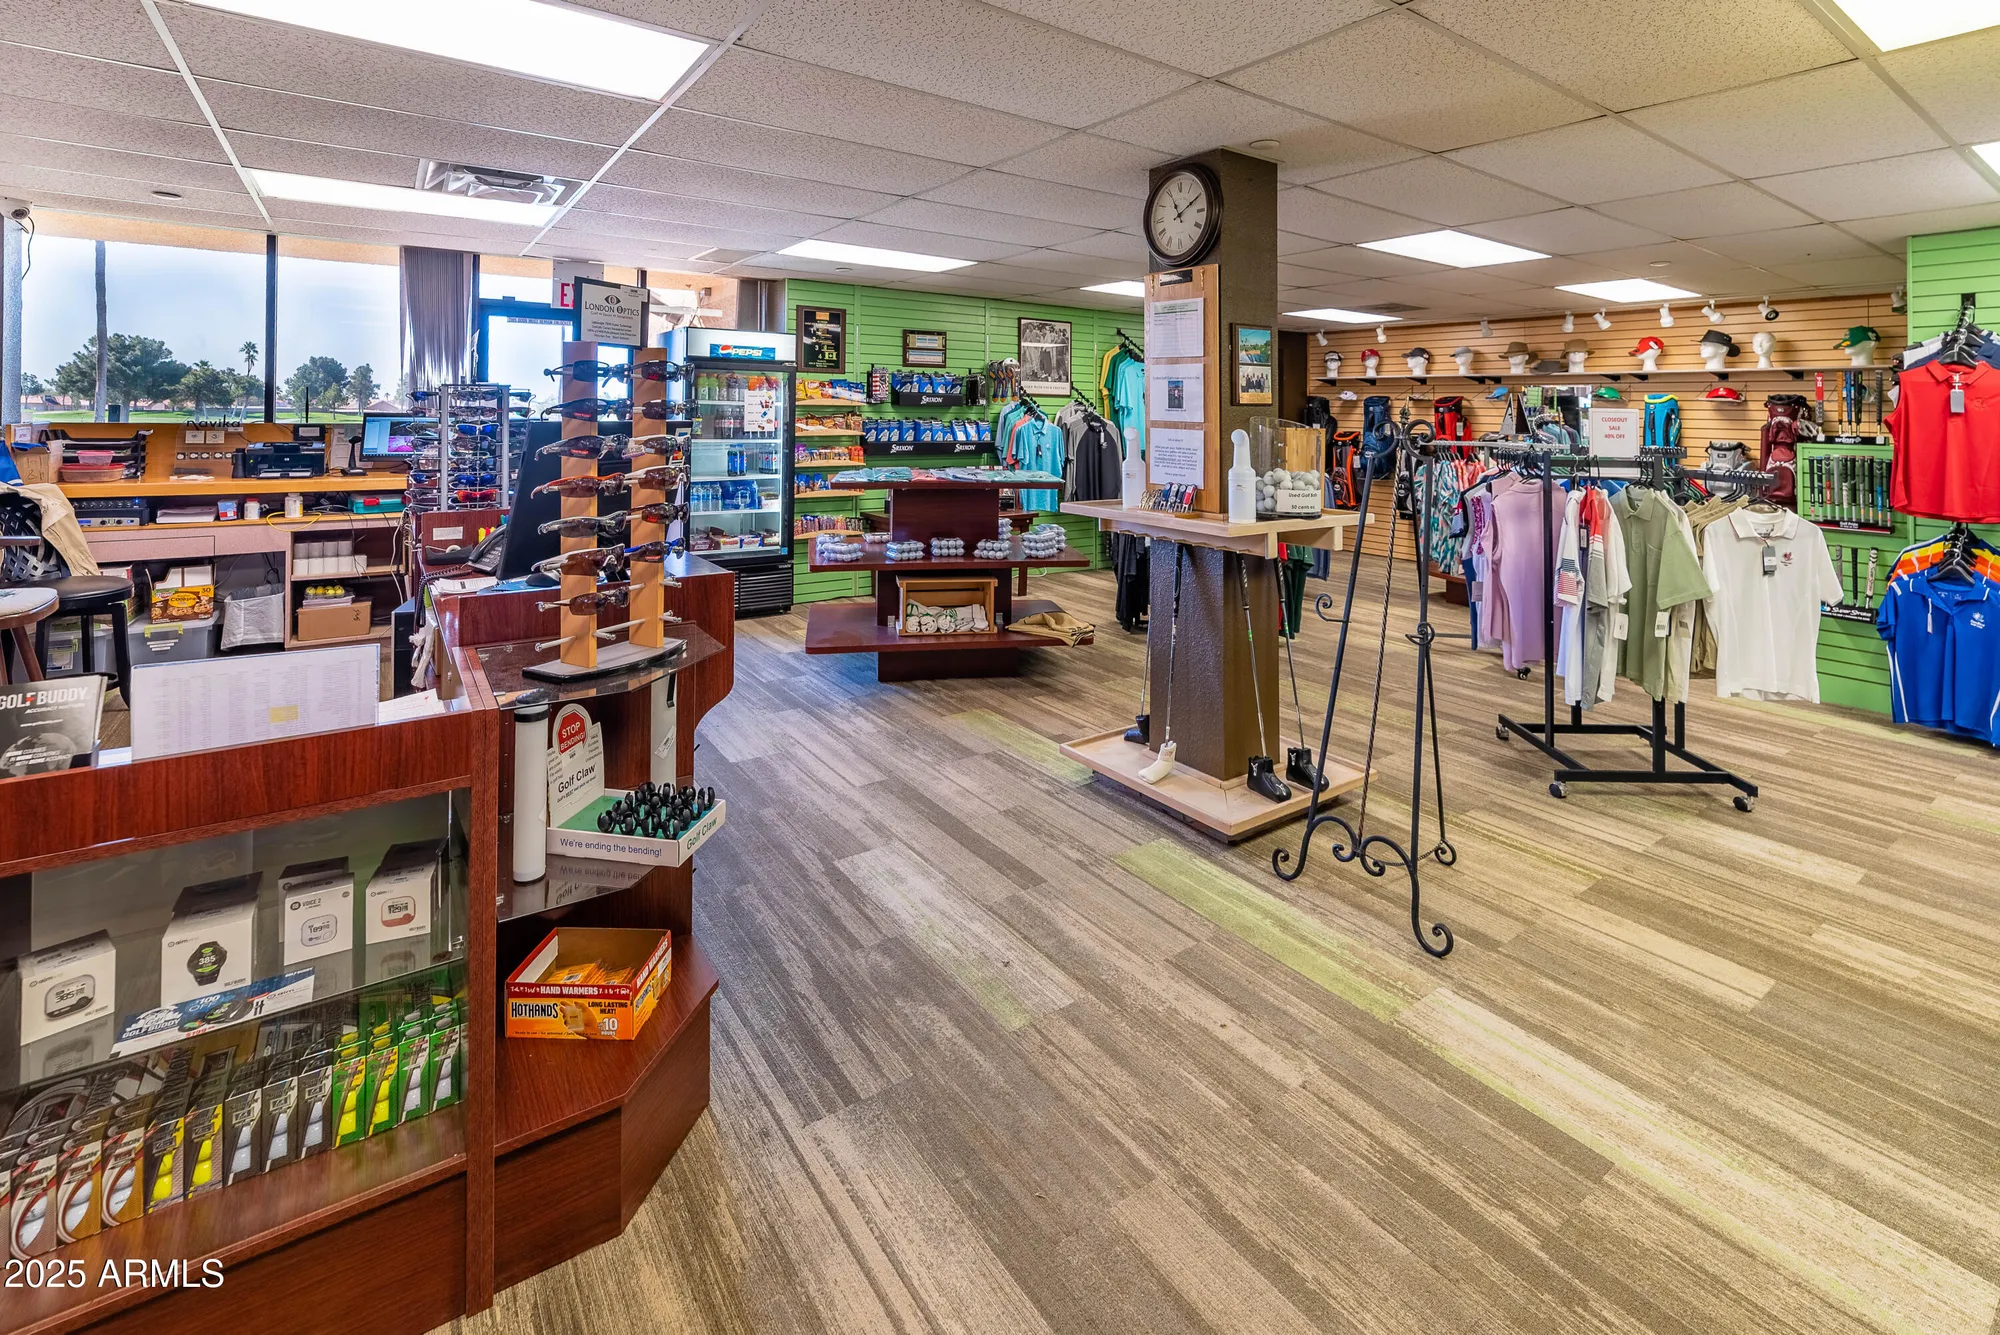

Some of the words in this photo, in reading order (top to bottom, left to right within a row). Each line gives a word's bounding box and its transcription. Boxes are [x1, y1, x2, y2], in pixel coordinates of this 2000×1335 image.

[585, 301, 615, 313] LONDON
[617, 305, 640, 317] OPTICS
[732, 348, 763, 357] PEPSI
[920, 395, 943, 405] SRIXON
[186, 414, 241, 431] navika
[890, 443, 914, 454] SRIXON
[954, 443, 976, 453] SRIXON
[561, 721, 581, 739] STOP
[558, 774, 575, 793] Golf
[576, 763, 596, 782] Claw
[687, 829, 701, 850] Golf
[702, 816, 718, 836] Claw
[560, 838, 583, 849] We're
[585, 842, 612, 853] ending
[613, 844, 626, 853] the
[628, 846, 662, 857] bending!
[303, 899, 316, 907] VOICE
[199, 955, 216, 965] 385
[540, 985, 561, 995] HAND
[562, 986, 598, 995] WARMERS
[511, 1001, 559, 1019] HOTHANDS
[122, 1027, 148, 1039] GOLF
[147, 1018, 181, 1032] BUDDY
[602, 1017, 619, 1031] 10
